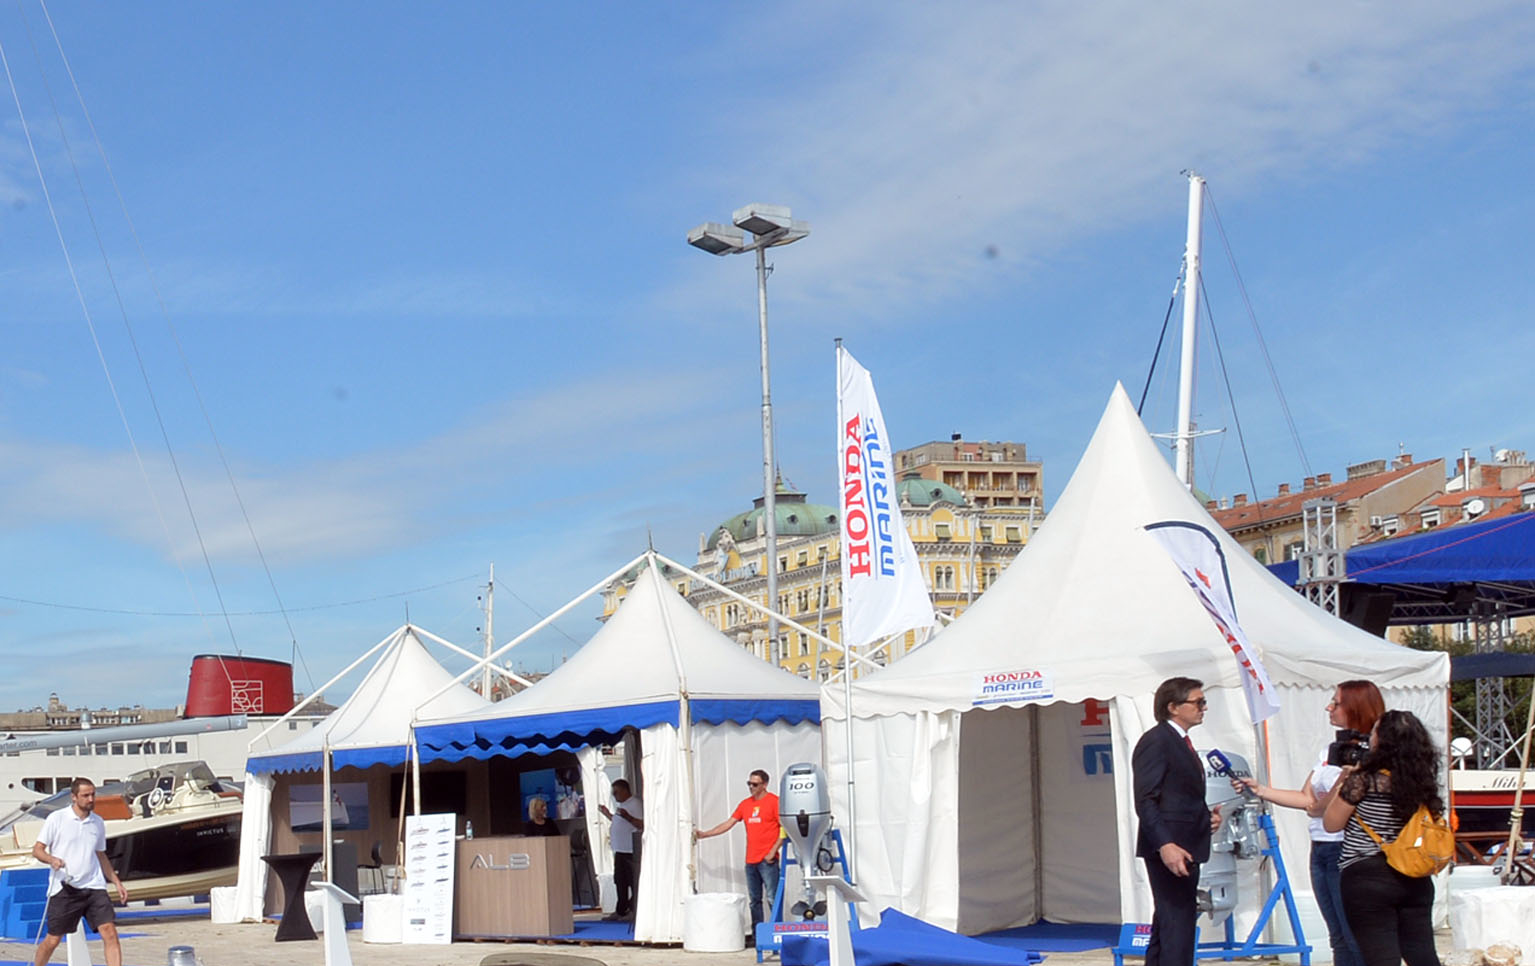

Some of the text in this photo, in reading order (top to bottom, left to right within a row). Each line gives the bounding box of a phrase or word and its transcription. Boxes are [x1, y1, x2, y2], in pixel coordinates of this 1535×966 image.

[845, 413, 871, 579] HONDA
[983, 670, 1042, 684] HONDA
[1207, 770, 1251, 778] HODA
[789, 782, 815, 791] 100
[470, 853, 530, 870] ALB
